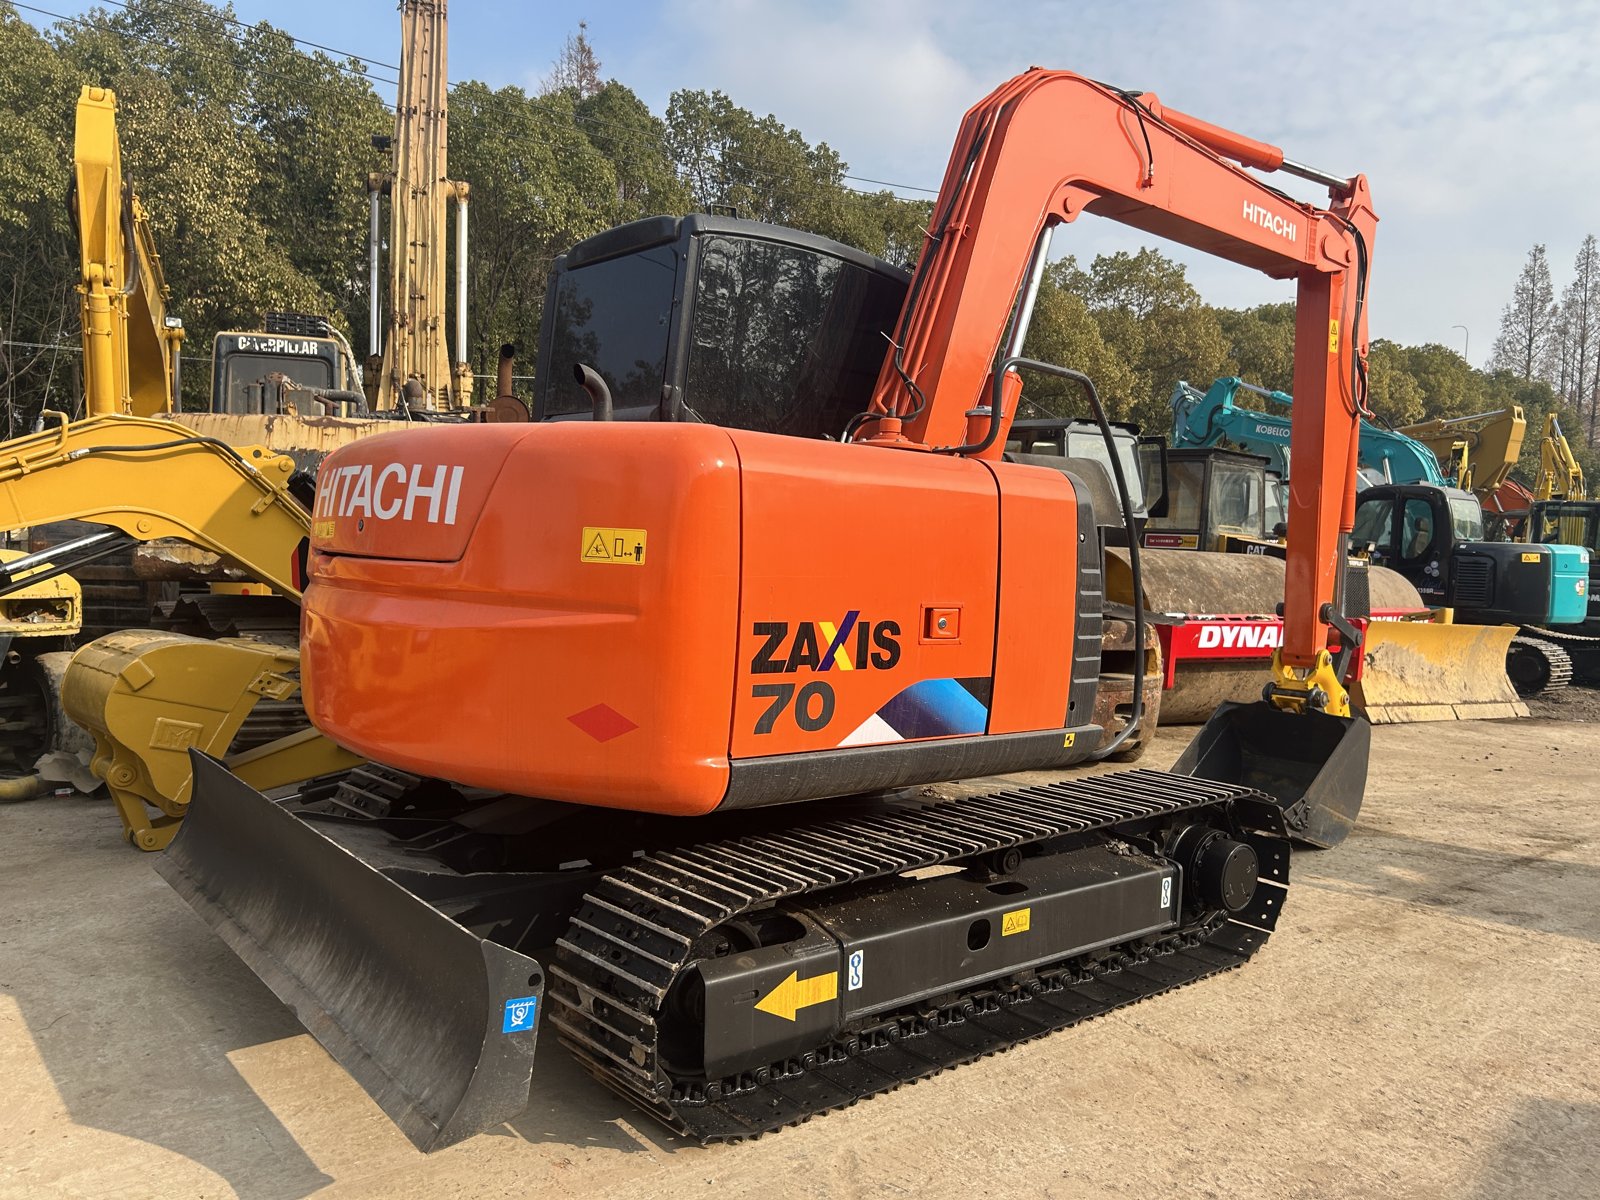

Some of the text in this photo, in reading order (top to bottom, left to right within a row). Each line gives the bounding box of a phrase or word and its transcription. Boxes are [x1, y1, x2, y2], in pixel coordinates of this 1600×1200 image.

[1243, 199, 1297, 242] HITACHI
[1255, 424, 1291, 438] KOBELCO
[315, 463, 465, 525] HITACHI
[1247, 544, 1266, 555] CAT
[750, 610, 901, 674] ZAXIS
[1198, 625, 1284, 649] DYNA
[751, 680, 836, 735] 70
